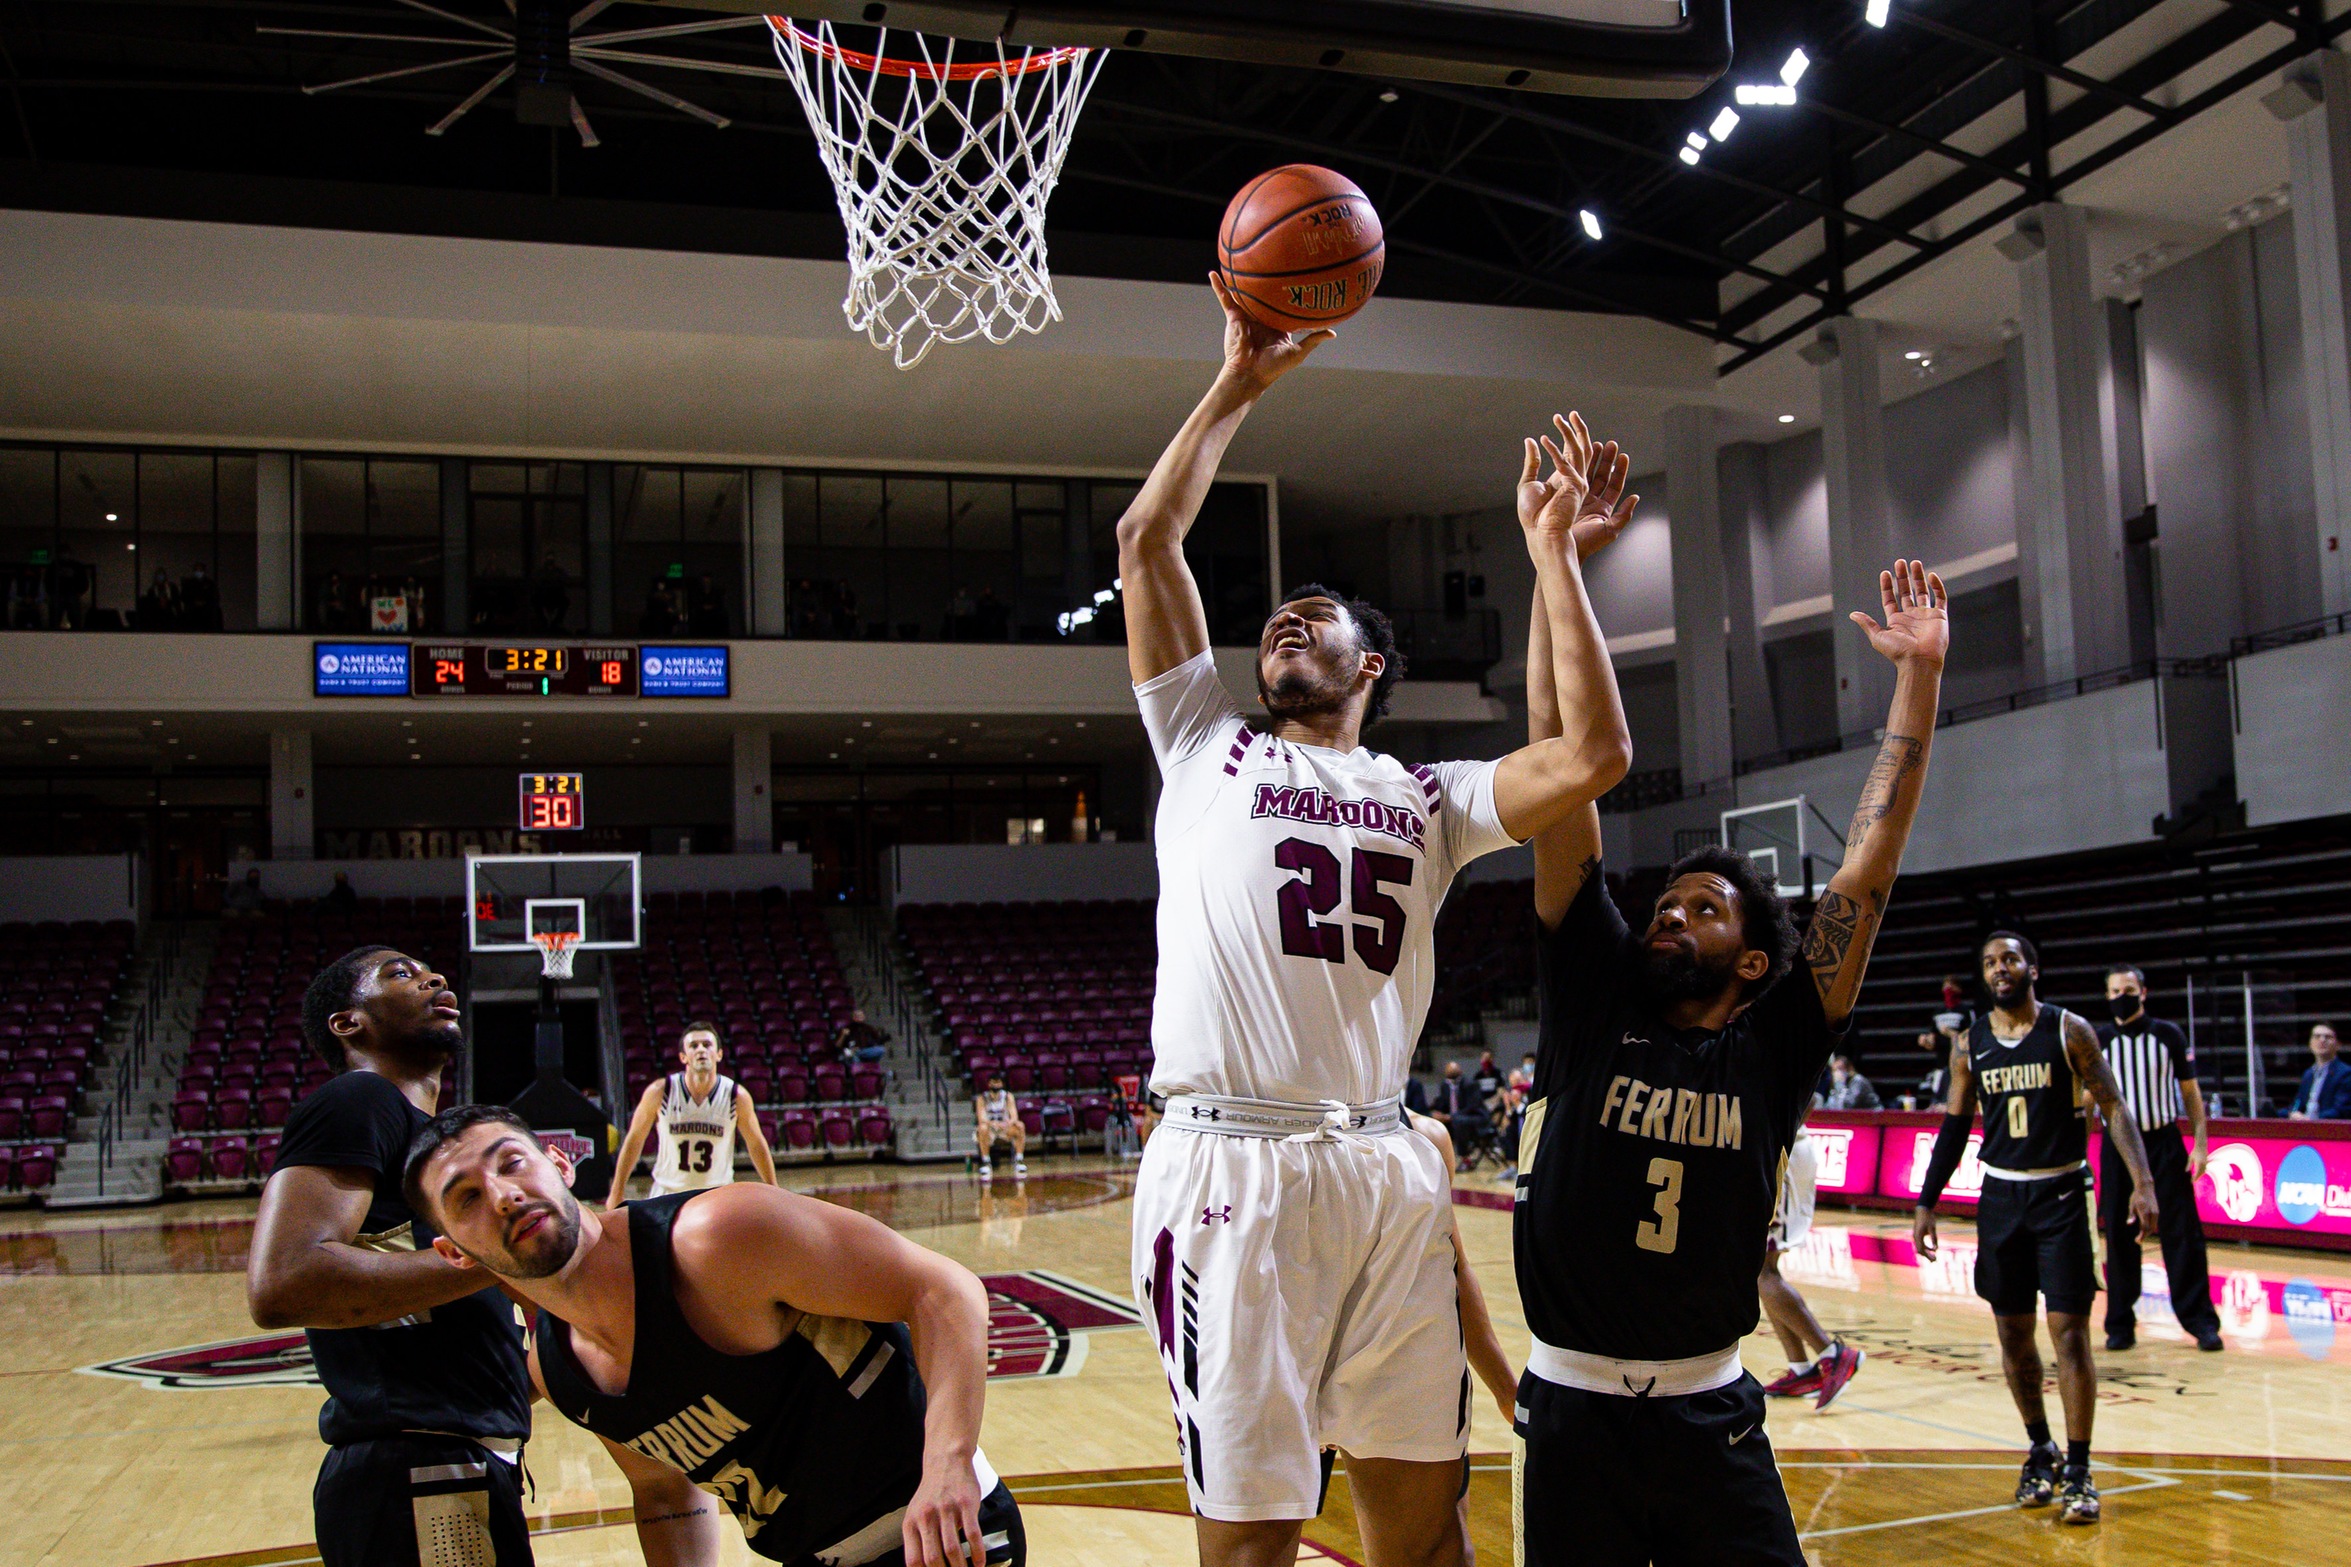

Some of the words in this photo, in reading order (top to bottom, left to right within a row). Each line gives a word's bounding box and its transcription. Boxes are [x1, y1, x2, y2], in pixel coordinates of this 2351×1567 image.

[1309, 204, 1352, 227] ROCK
[1288, 278, 1347, 311] ROCK
[341, 654, 406, 665] AMERICAN
[429, 647, 465, 660] HOME
[505, 648, 562, 672] 3:21
[582, 648, 630, 661] VISITOR
[663, 656, 724, 667] AMERICAN
[340, 663, 404, 674] NATIONAL
[435, 659, 465, 684] 24
[600, 660, 622, 685] 18
[663, 665, 722, 677] NATIONAL
[541, 676, 550, 697] 1
[534, 776, 581, 794] 3:21
[532, 796, 572, 828] 30
[1250, 783, 1427, 858] MAROONS
[324, 828, 543, 860] MAROONS
[1274, 836, 1414, 977] 25
[1981, 1062, 2052, 1095] FERRUM
[1599, 1075, 1742, 1150] FERRUM
[2008, 1096, 2029, 1139] 0
[669, 1122, 724, 1138] MAROONS
[678, 1139, 713, 1173] 13
[1636, 1157, 1684, 1254] 3
